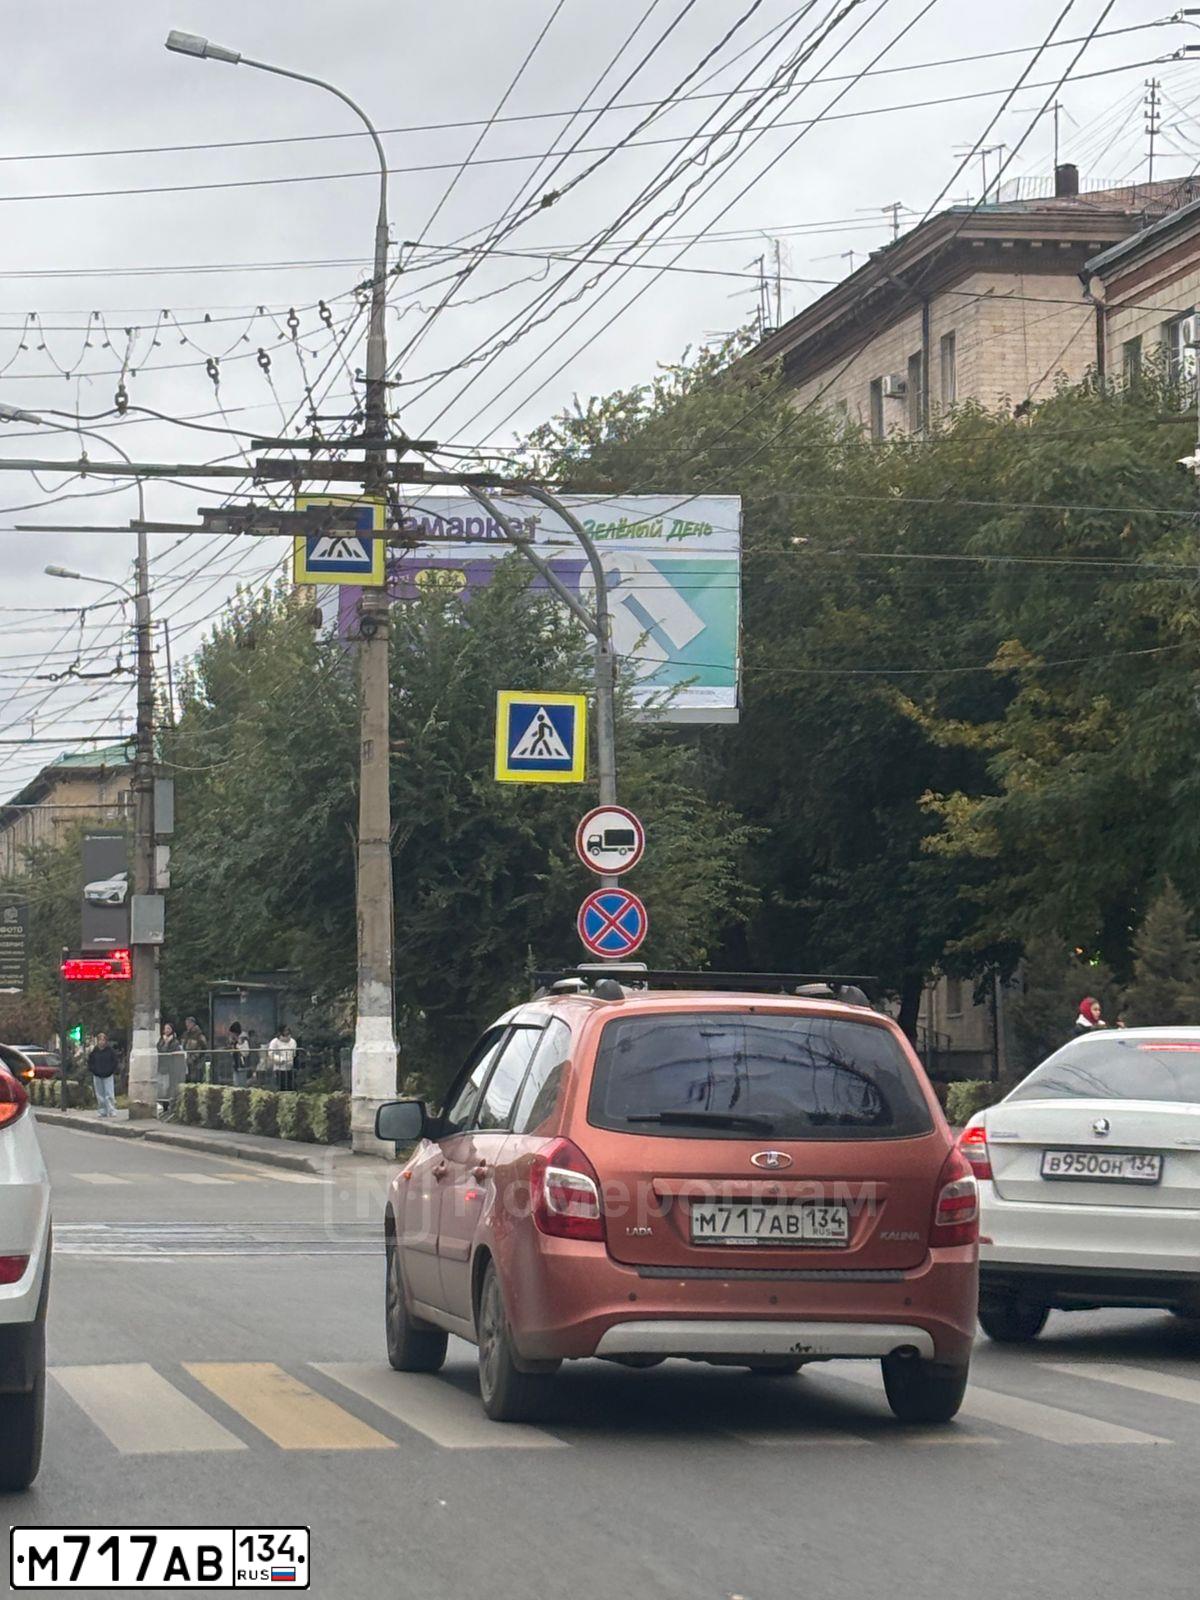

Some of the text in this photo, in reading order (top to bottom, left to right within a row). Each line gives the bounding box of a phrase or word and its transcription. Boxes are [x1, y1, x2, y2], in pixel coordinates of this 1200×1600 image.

[389, 516, 541, 544] амаркет
[1049, 1153, 1157, 1174] В950ОН 134
[625, 1226, 653, 1236] LADA
[700, 1208, 845, 1234] М717АВ 134
[880, 1231, 920, 1241] KALINA
